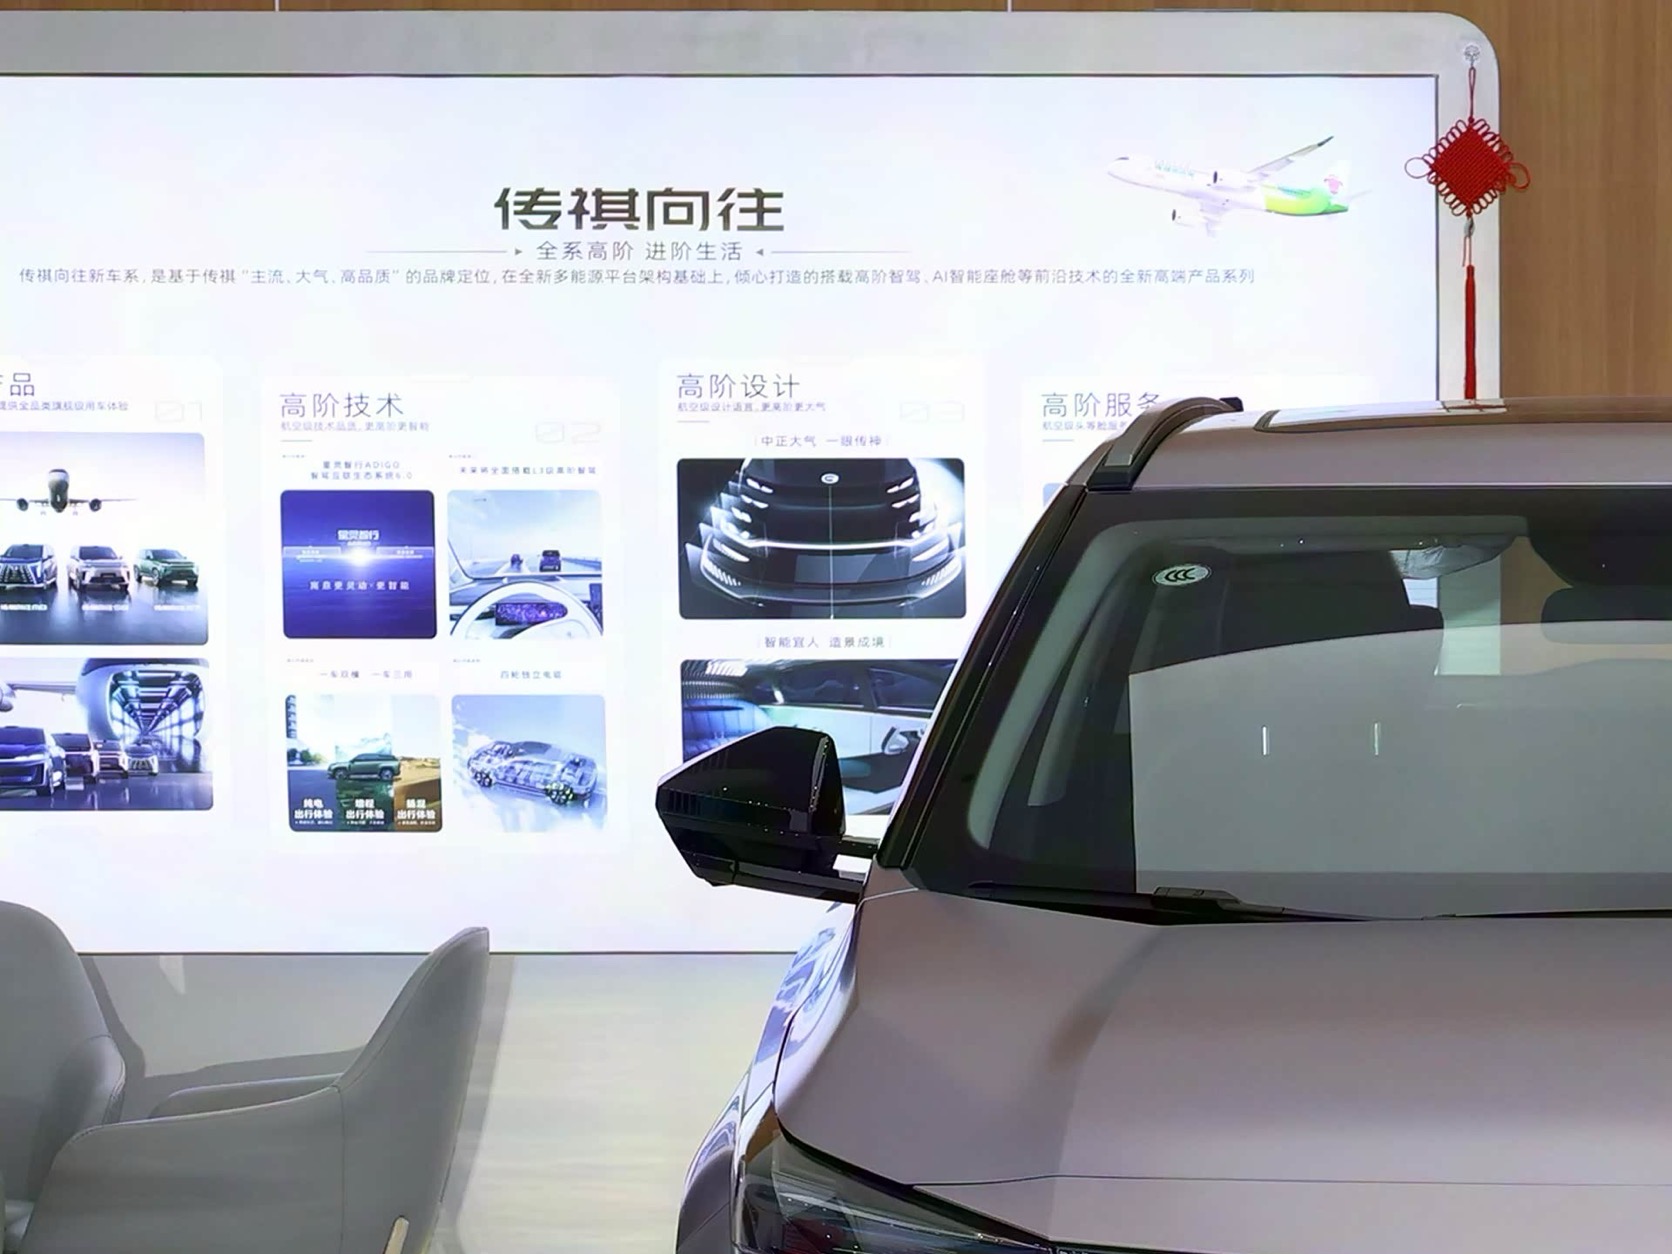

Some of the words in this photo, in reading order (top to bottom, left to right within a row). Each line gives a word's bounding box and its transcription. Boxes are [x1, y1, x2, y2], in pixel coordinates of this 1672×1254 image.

[493, 186, 786, 233] 传祺向往
[536, 240, 635, 262] 全系高阶
[645, 240, 744, 262] 进阶生活
[676, 372, 801, 400] 高阶设计
[279, 391, 405, 418] 高阶技术
[760, 435, 818, 448] 中正大气
